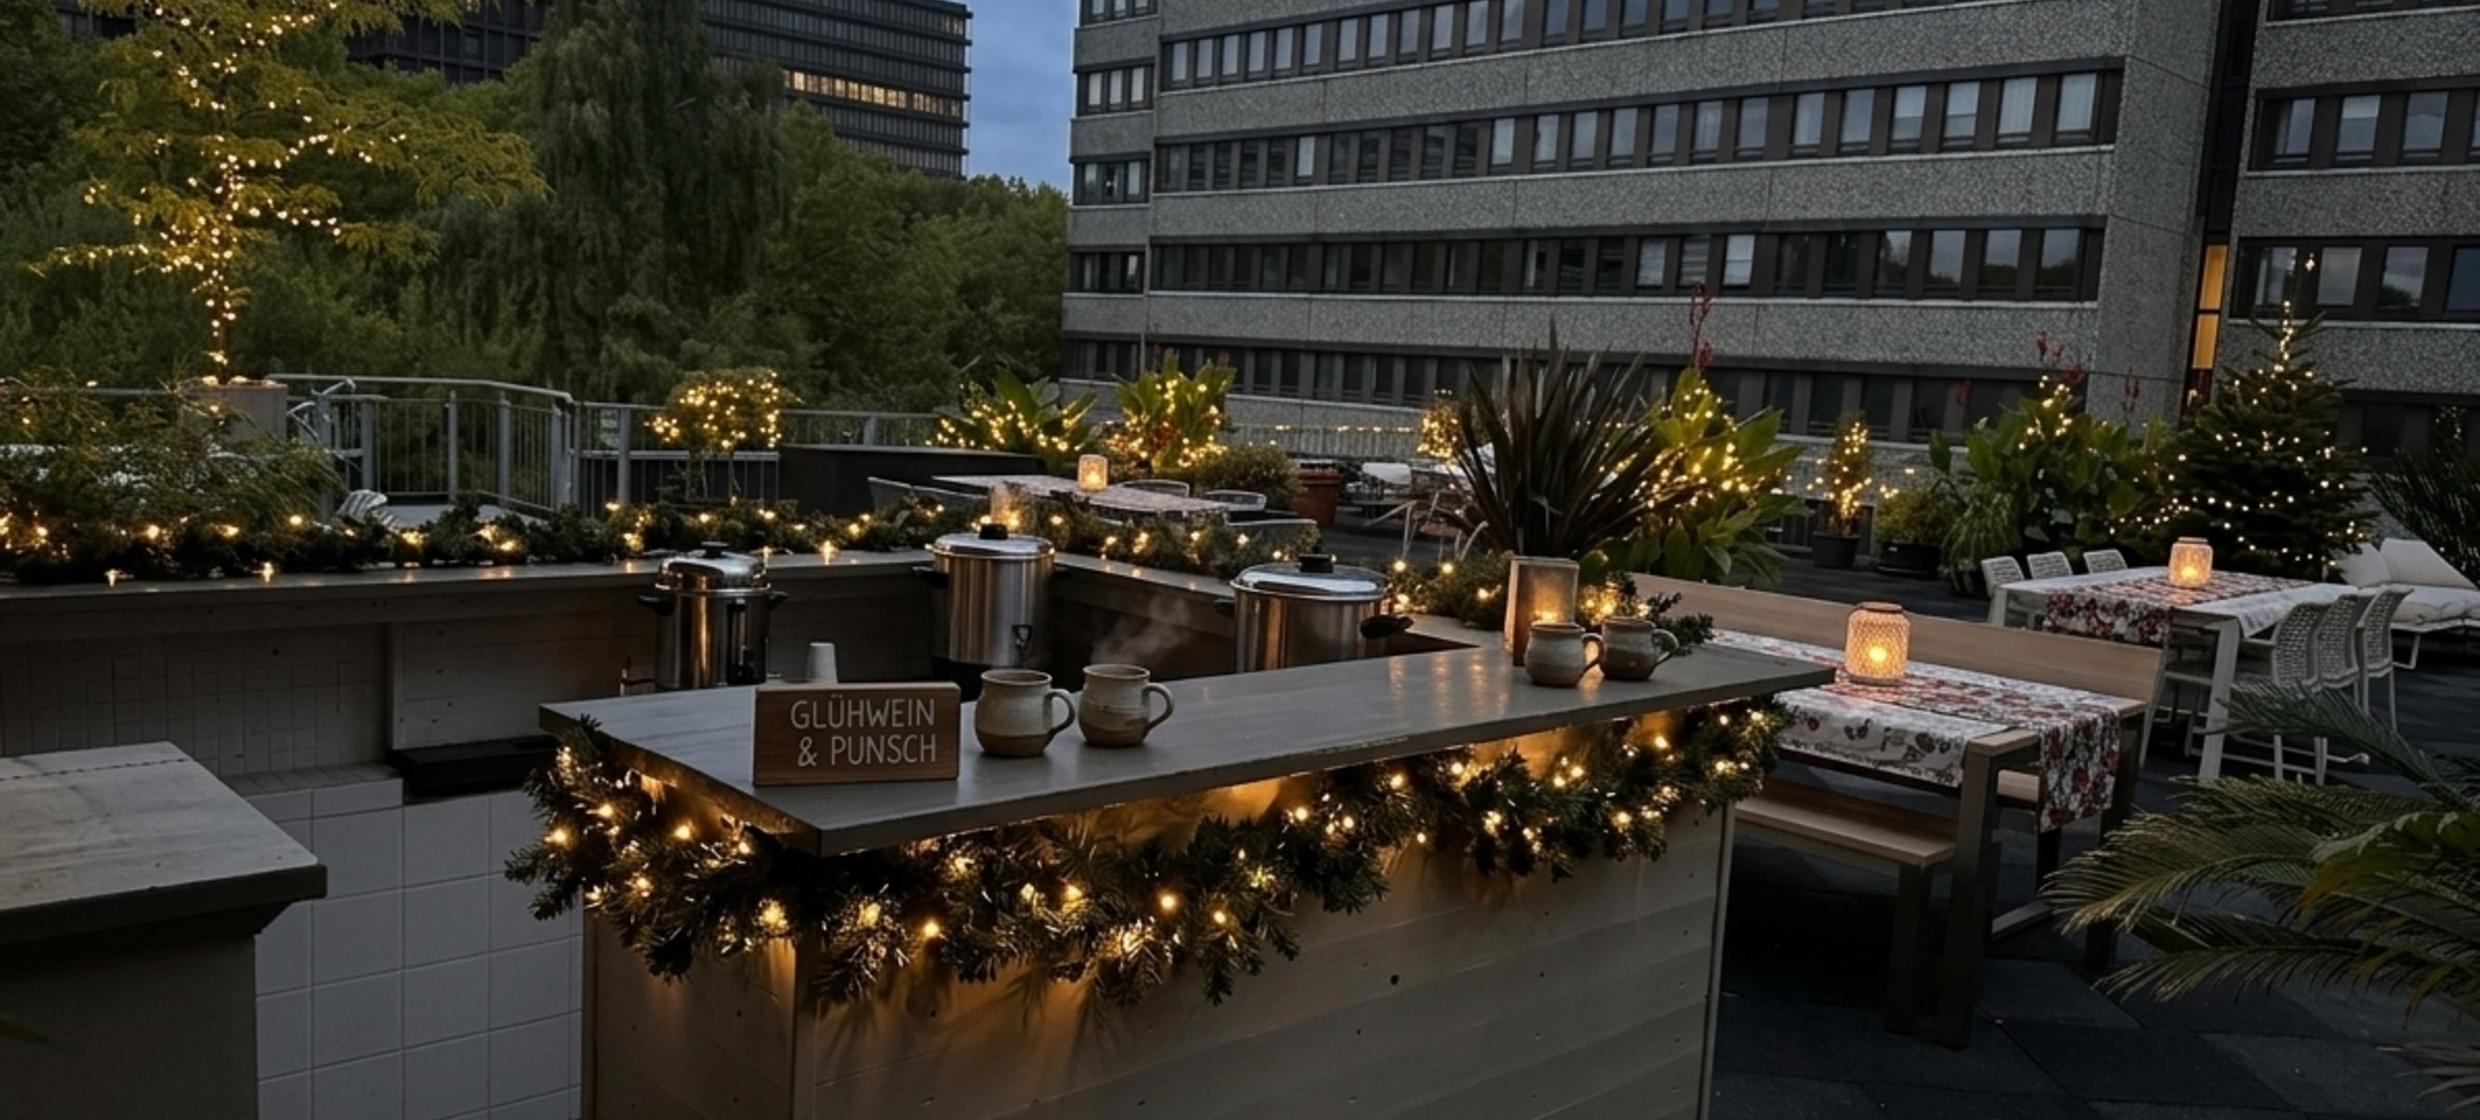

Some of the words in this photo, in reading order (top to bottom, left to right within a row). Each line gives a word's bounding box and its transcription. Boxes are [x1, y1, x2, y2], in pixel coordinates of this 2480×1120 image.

[790, 694, 935, 729] GLÜHWEIN
[798, 736, 818, 767] &
[831, 733, 936, 765] PUNSCH
